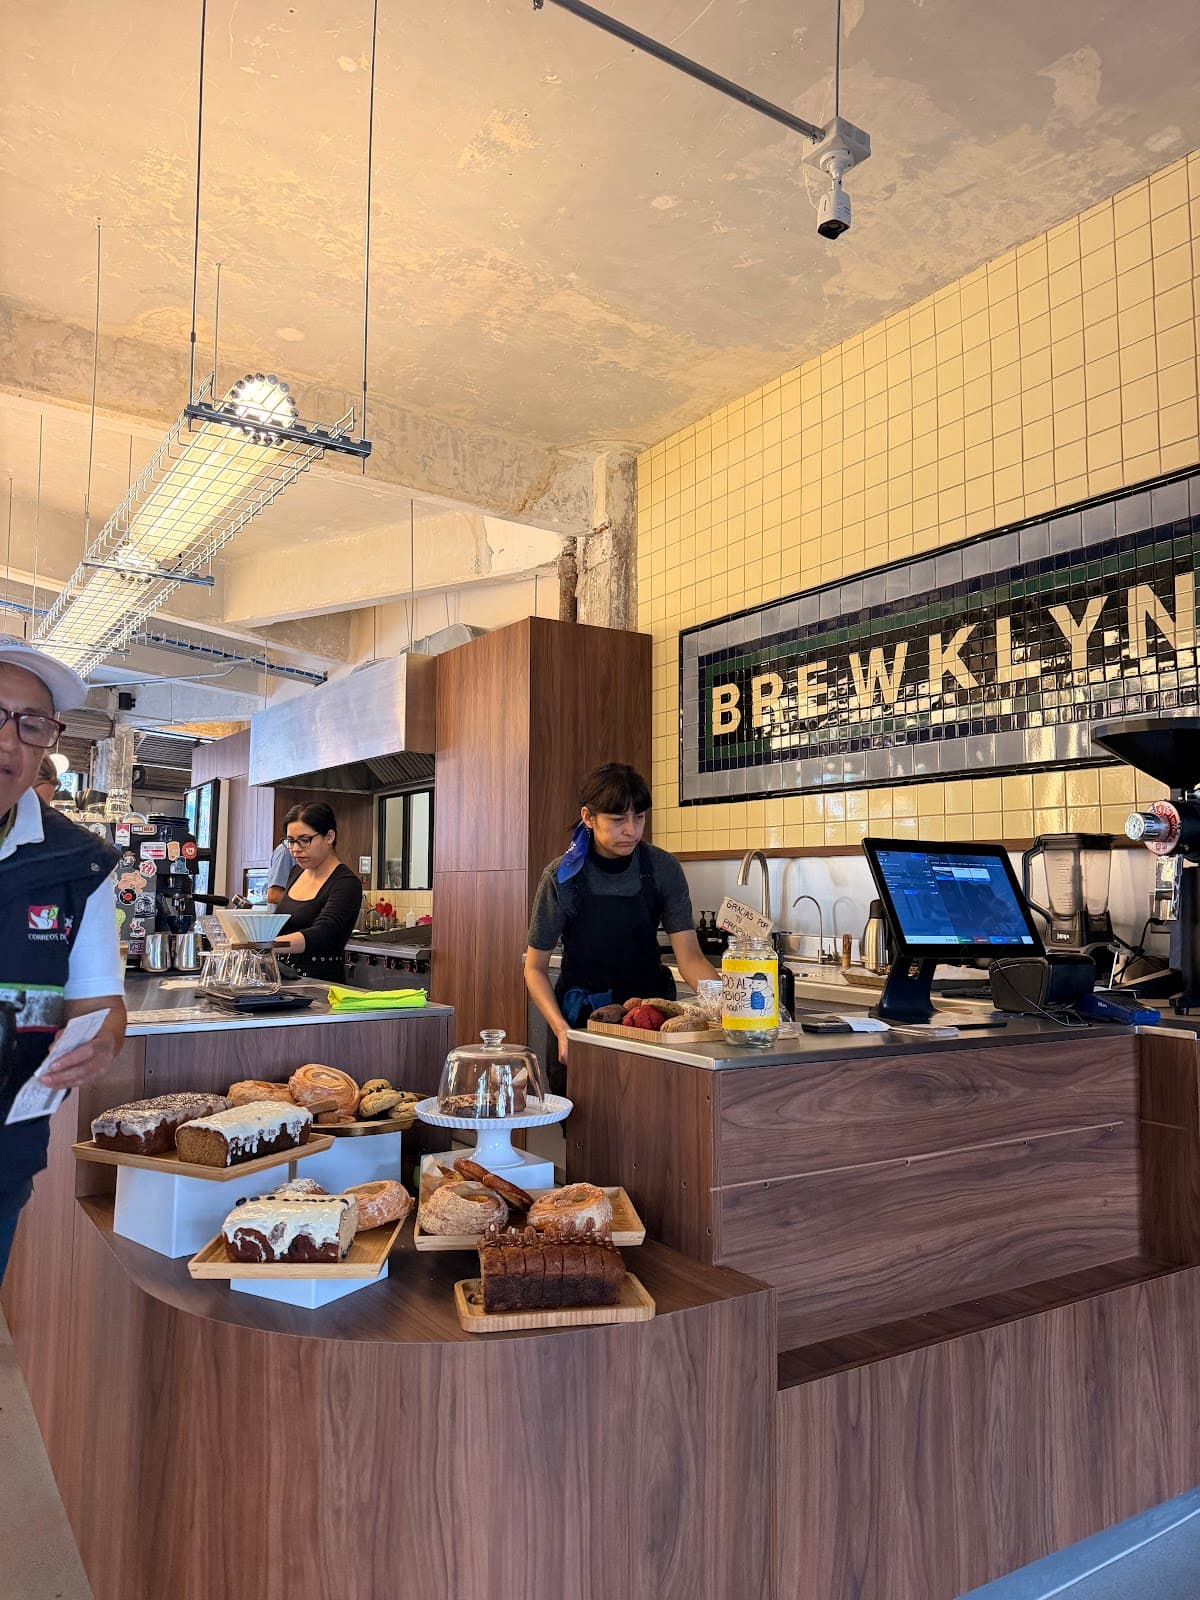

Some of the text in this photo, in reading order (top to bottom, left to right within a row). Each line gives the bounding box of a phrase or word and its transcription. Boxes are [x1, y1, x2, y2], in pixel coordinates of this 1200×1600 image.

[711, 574, 1196, 736] BREWKLYN
[726, 899, 754, 921] GRACIAS
[736, 977, 748, 990] AL
